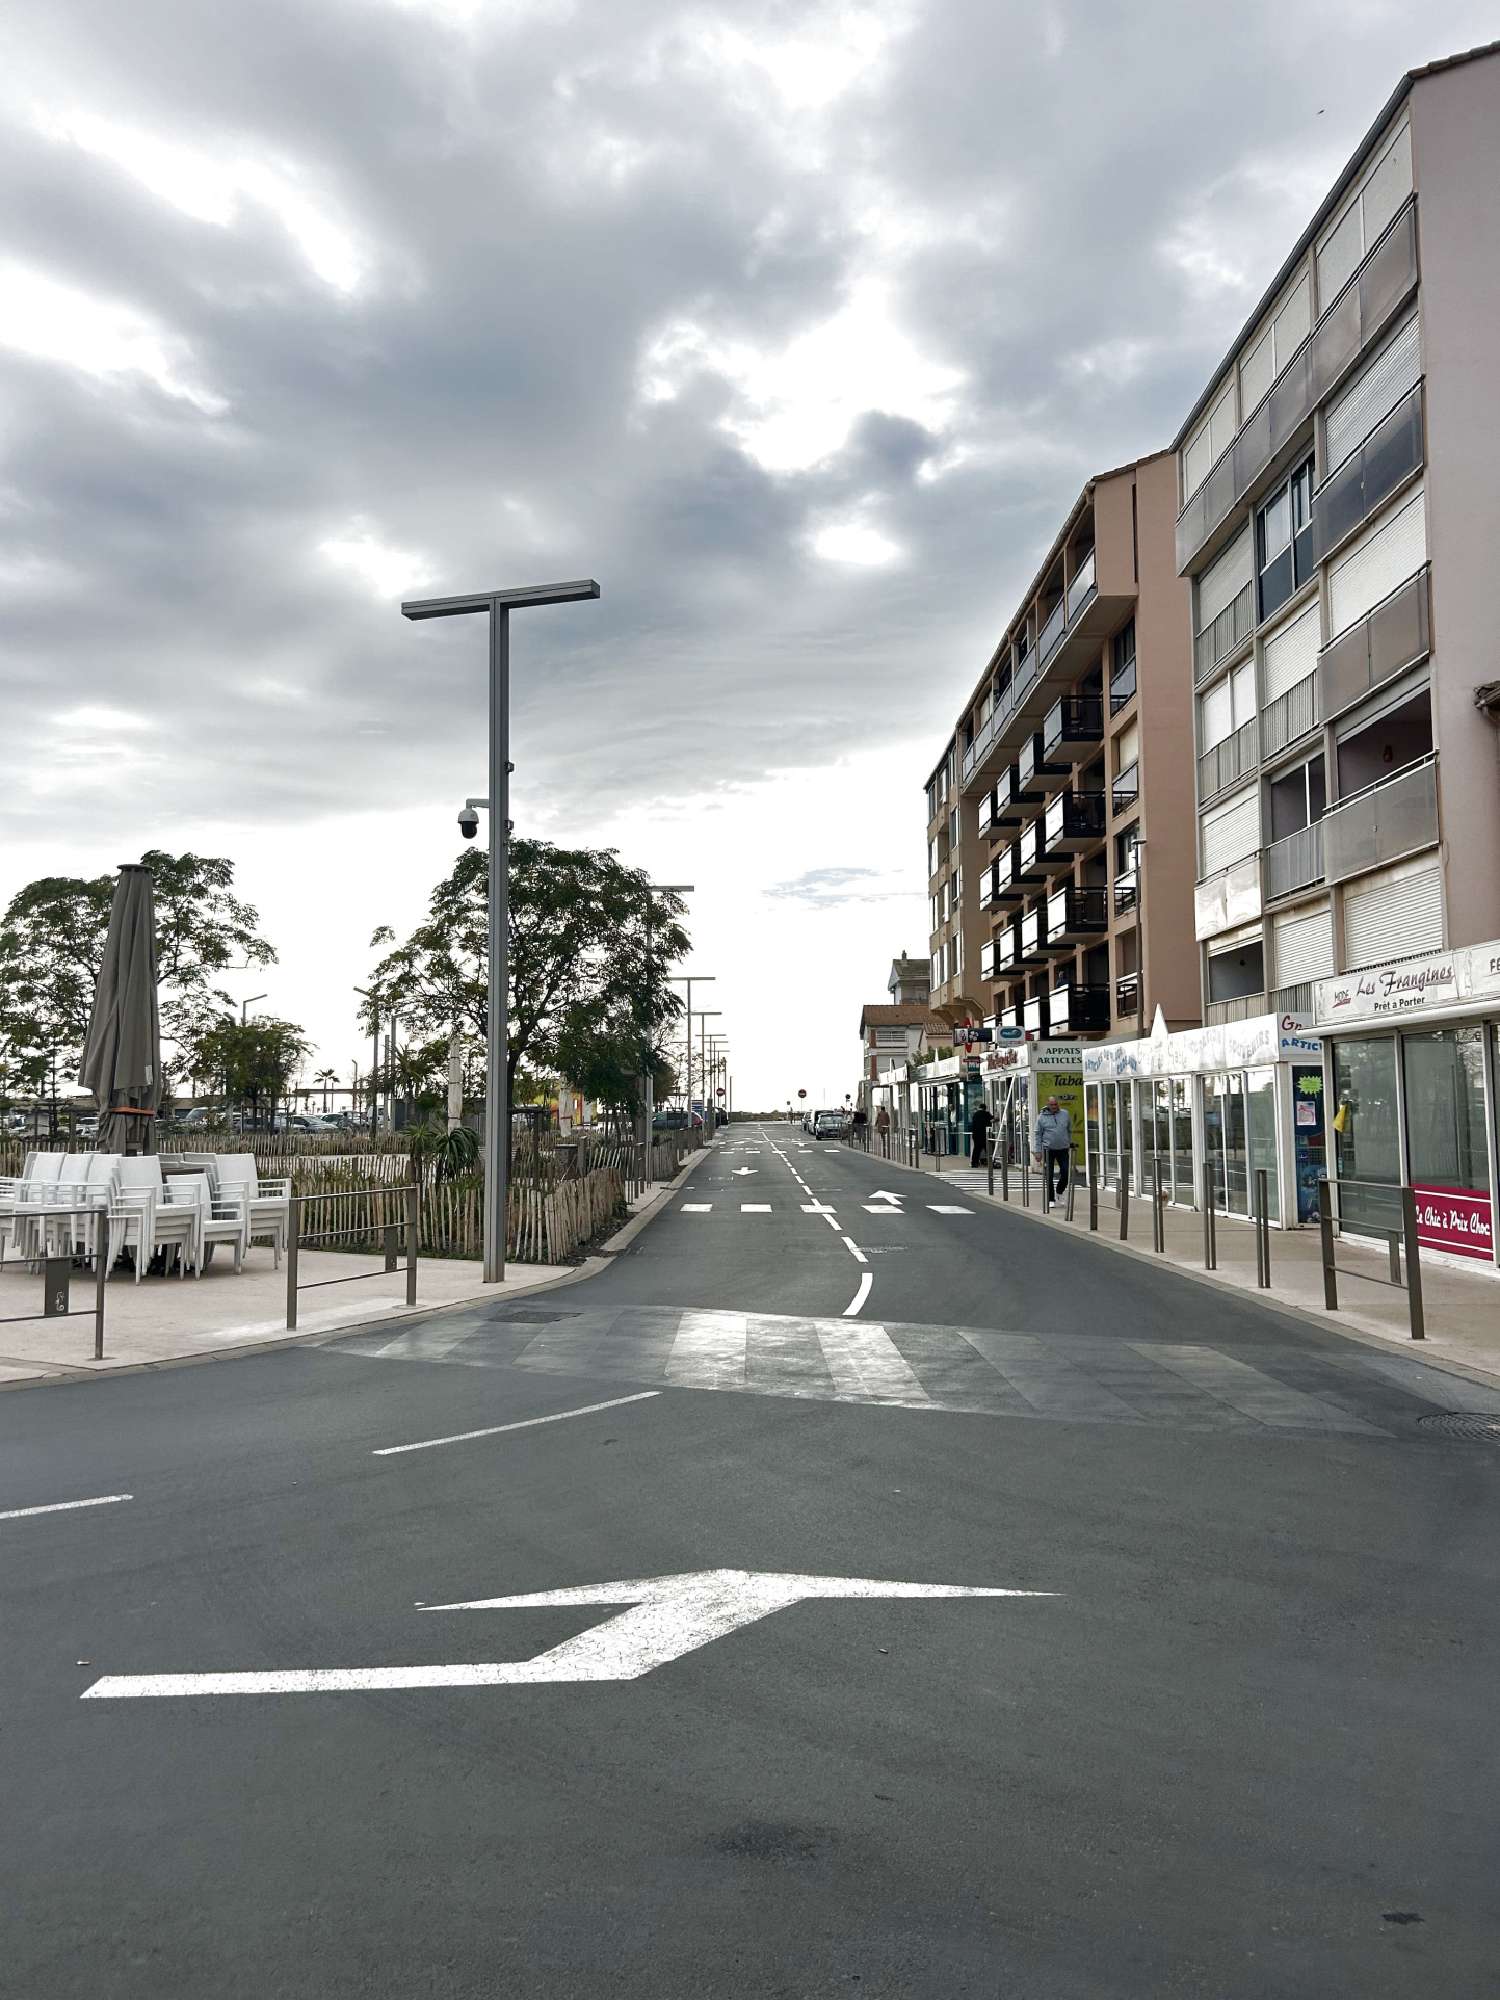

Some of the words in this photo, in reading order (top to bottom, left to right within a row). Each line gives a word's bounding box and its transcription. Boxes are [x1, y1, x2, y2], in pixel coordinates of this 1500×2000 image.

[1357, 976, 1376, 996] Les
[1379, 966, 1454, 997] Frangines
[1399, 997, 1425, 1007] Porter
[1281, 1015, 1303, 1031] Gr
[1038, 1056, 1082, 1064] ARTICLES
[1425, 1206, 1441, 1227] Chic
[1443, 1212, 1448, 1229] à
[1449, 1210, 1468, 1232] Prix
[1470, 1213, 1490, 1236] Choc
